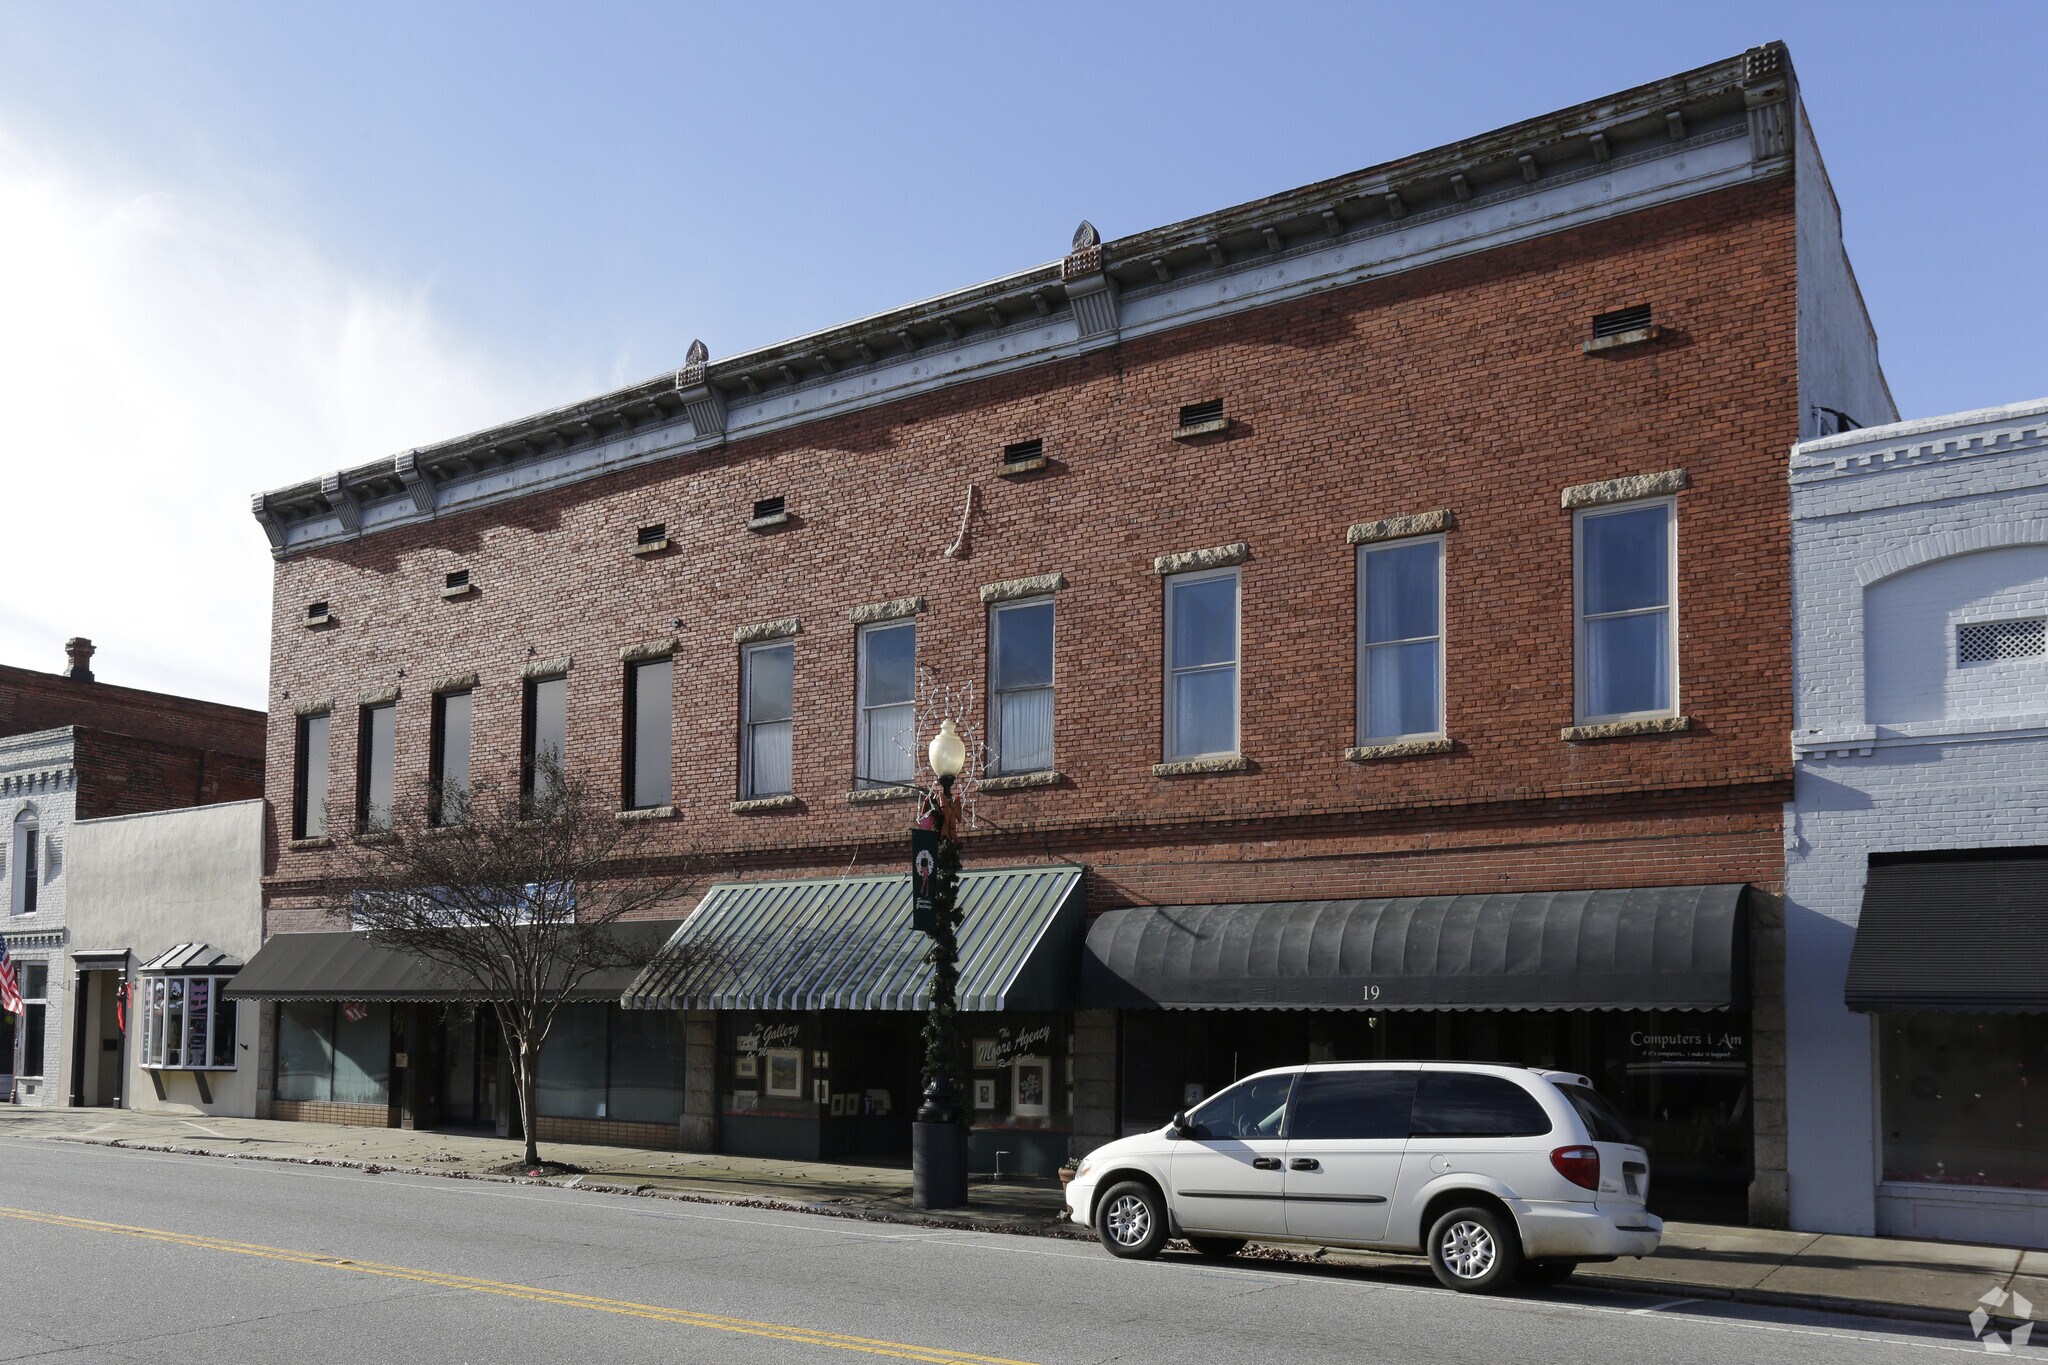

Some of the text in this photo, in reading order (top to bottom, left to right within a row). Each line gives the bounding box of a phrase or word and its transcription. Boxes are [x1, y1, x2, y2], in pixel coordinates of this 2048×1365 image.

[1363, 985, 1380, 1001] 19
[763, 1023, 800, 1047] Gallery
[998, 1027, 1011, 1039] The
[1630, 1031, 1742, 1049] Computers i Am
[978, 1026, 1050, 1062] Moore Agency
[997, 1056, 1013, 1069] Real
